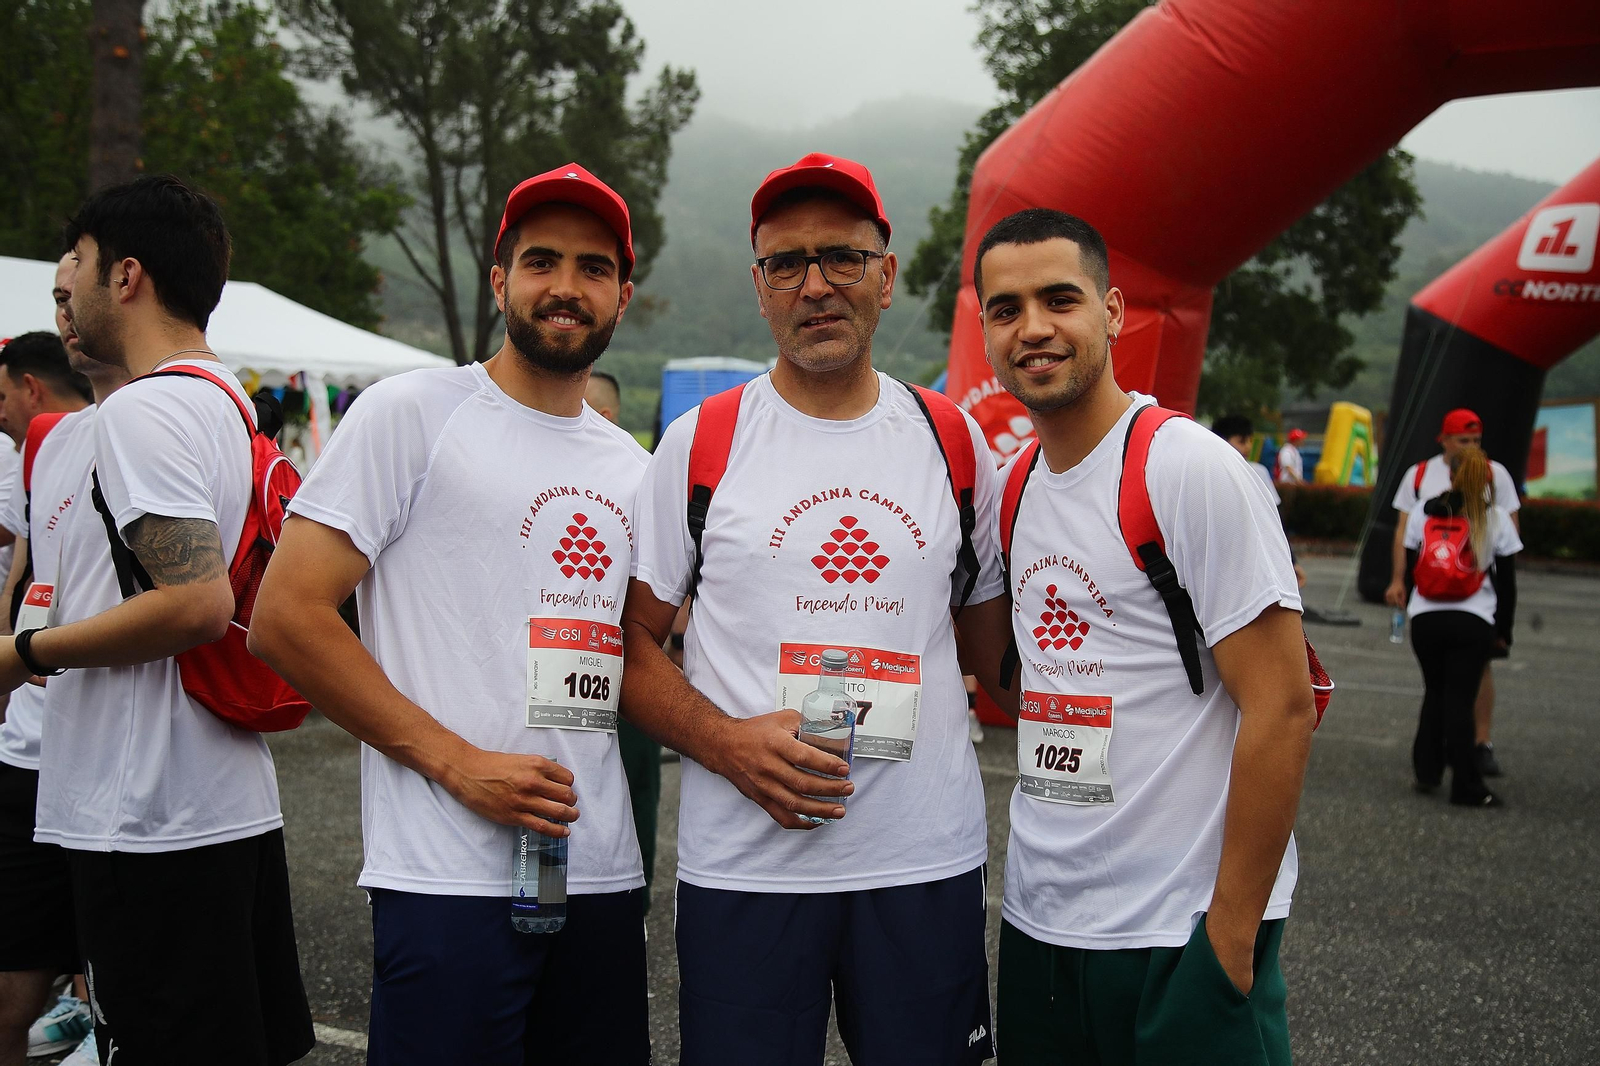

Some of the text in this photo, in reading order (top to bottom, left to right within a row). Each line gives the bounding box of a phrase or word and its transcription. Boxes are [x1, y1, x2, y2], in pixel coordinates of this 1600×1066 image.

[46, 515, 59, 532] III
[519, 486, 633, 553] III ANDAINA CAMPEIRA
[769, 487, 927, 550] III ANDAINA CAMPEIRA
[1016, 554, 1059, 598] ANDAINA
[1061, 555, 1115, 619] CAMPEIRA
[540, 588, 589, 609] Facendo
[795, 593, 905, 617] Facendo Piña!
[559, 628, 581, 642] GSI
[579, 656, 604, 668] MIGUEL
[881, 661, 917, 675] Mediplus
[1066, 658, 1105, 678] Piña!
[563, 672, 611, 702] 1026
[1027, 700, 1041, 714] GSI
[1074, 706, 1108, 718] Mediplus
[1041, 726, 1076, 740] MARCOS
[1034, 742, 1084, 774] 1025
[968, 1024, 987, 1048] FILA
